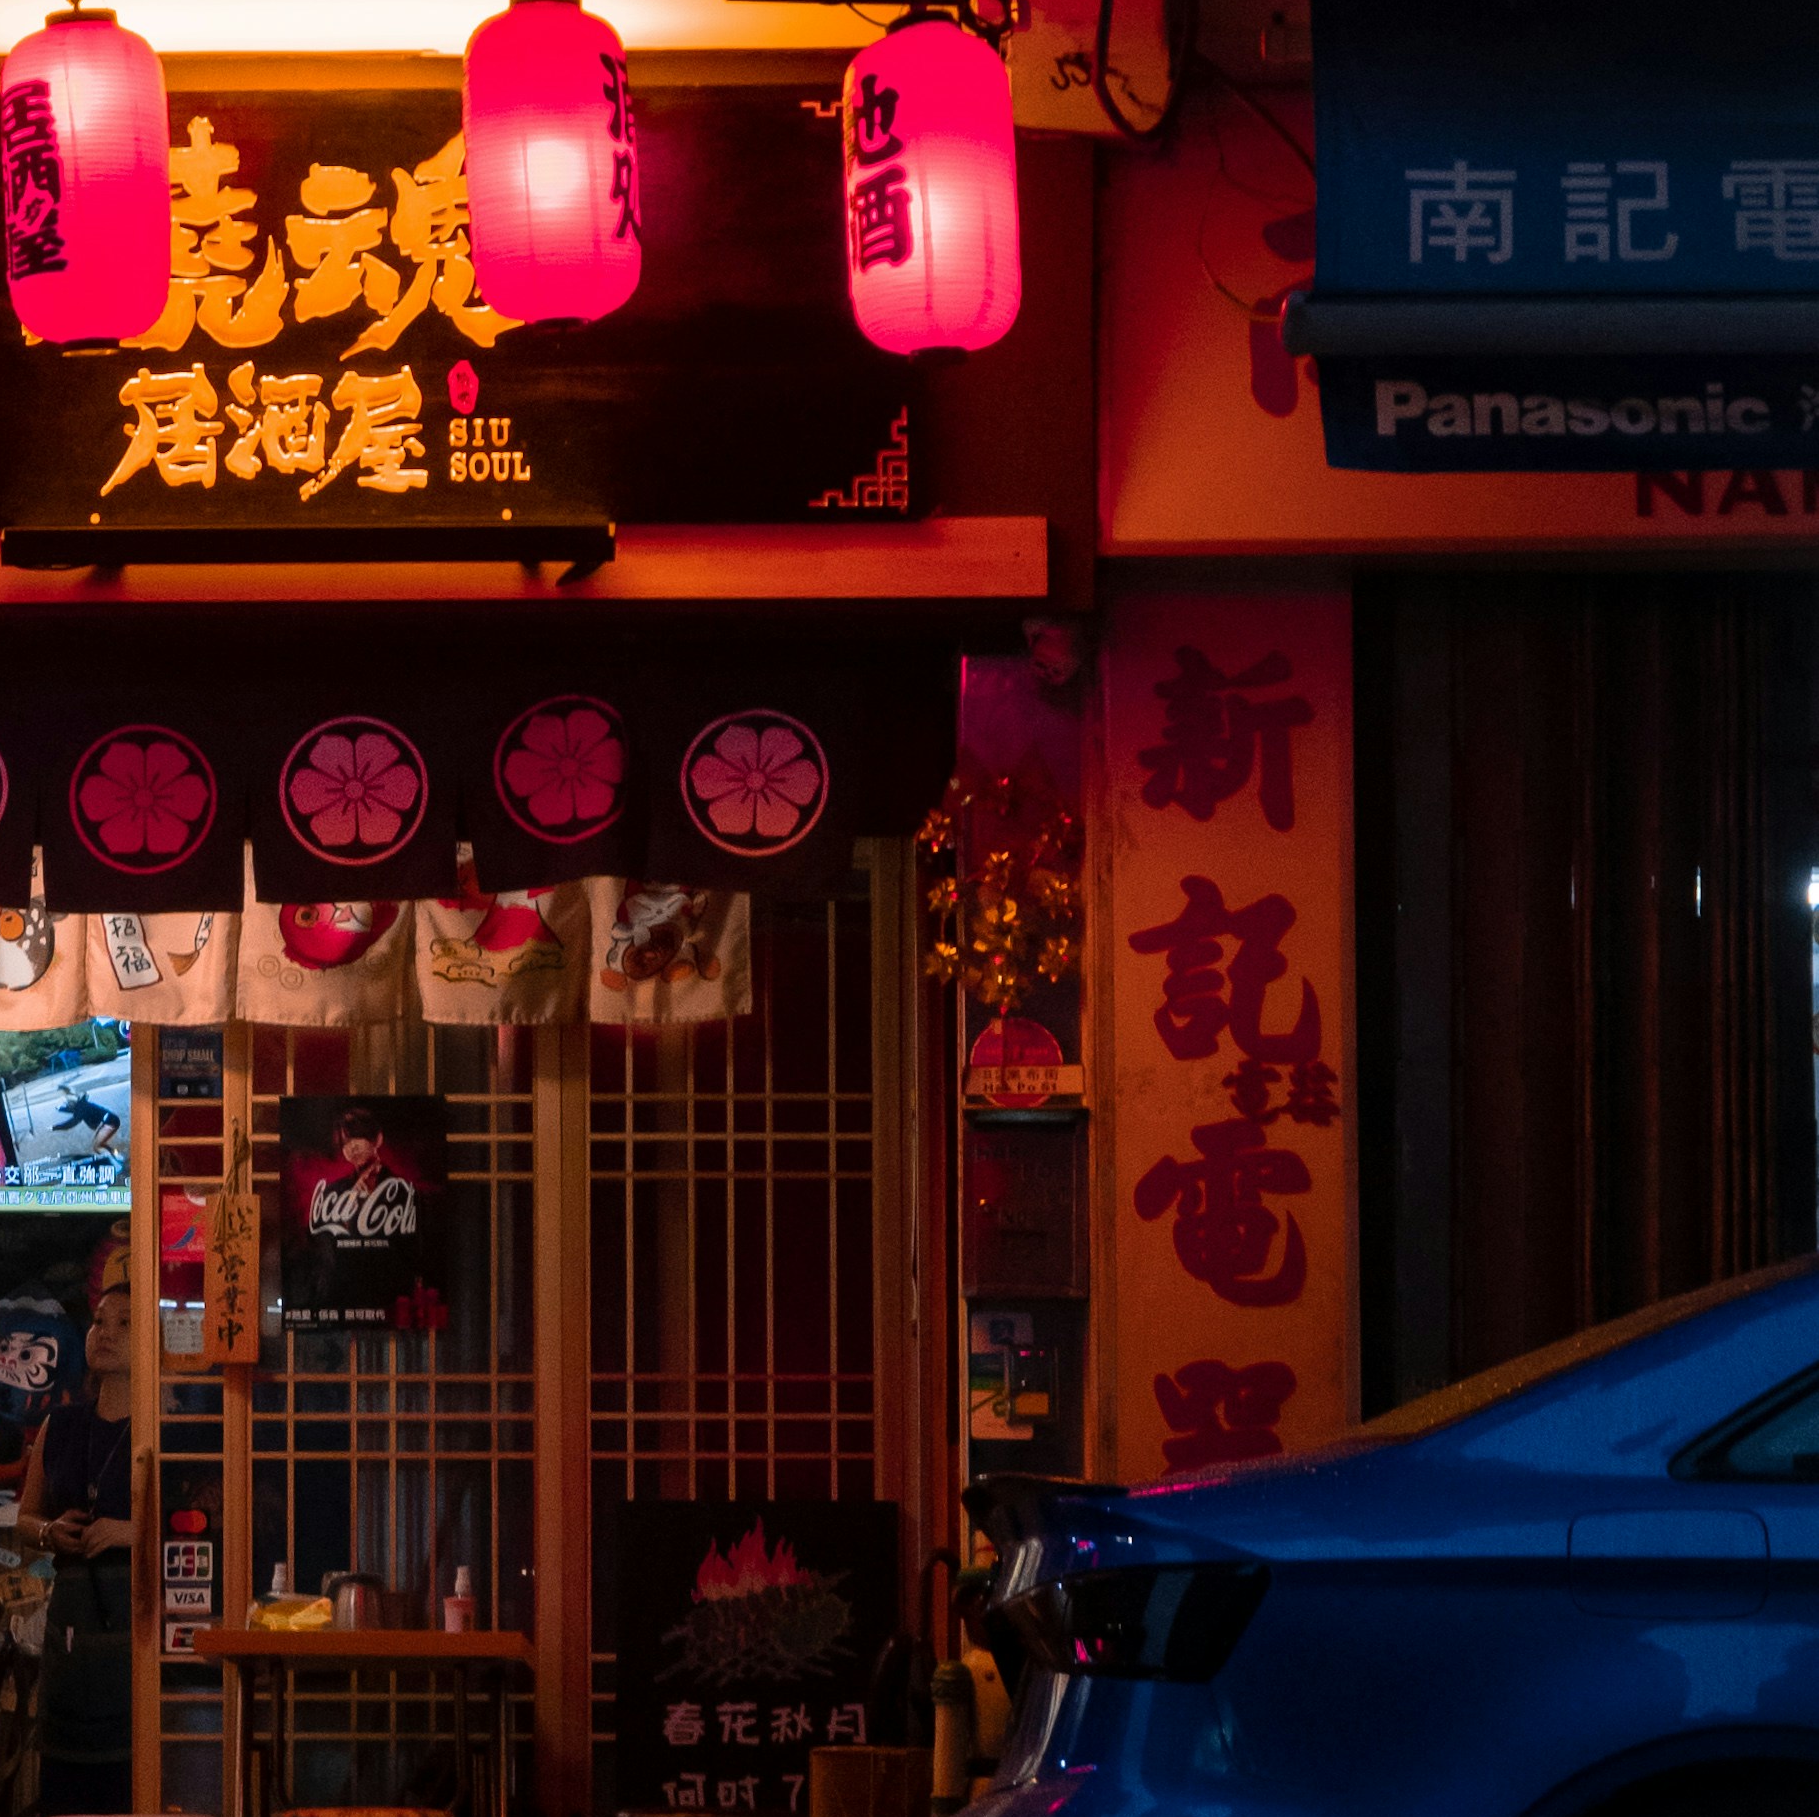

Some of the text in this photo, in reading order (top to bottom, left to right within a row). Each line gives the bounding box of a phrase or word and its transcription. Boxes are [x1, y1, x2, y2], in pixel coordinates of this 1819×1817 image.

[1404, 159, 1819, 264] 南記電
[100, 360, 429, 501] 居酒屋
[1373, 380, 1771, 437] Panasonic
[449, 417, 511, 447] SIU
[450, 451, 531, 482] SOUL
[1636, 469, 1819, 517] NA
[174, 1591, 205, 1604] VISA
[662, 1701, 867, 1745] 春花秋月
